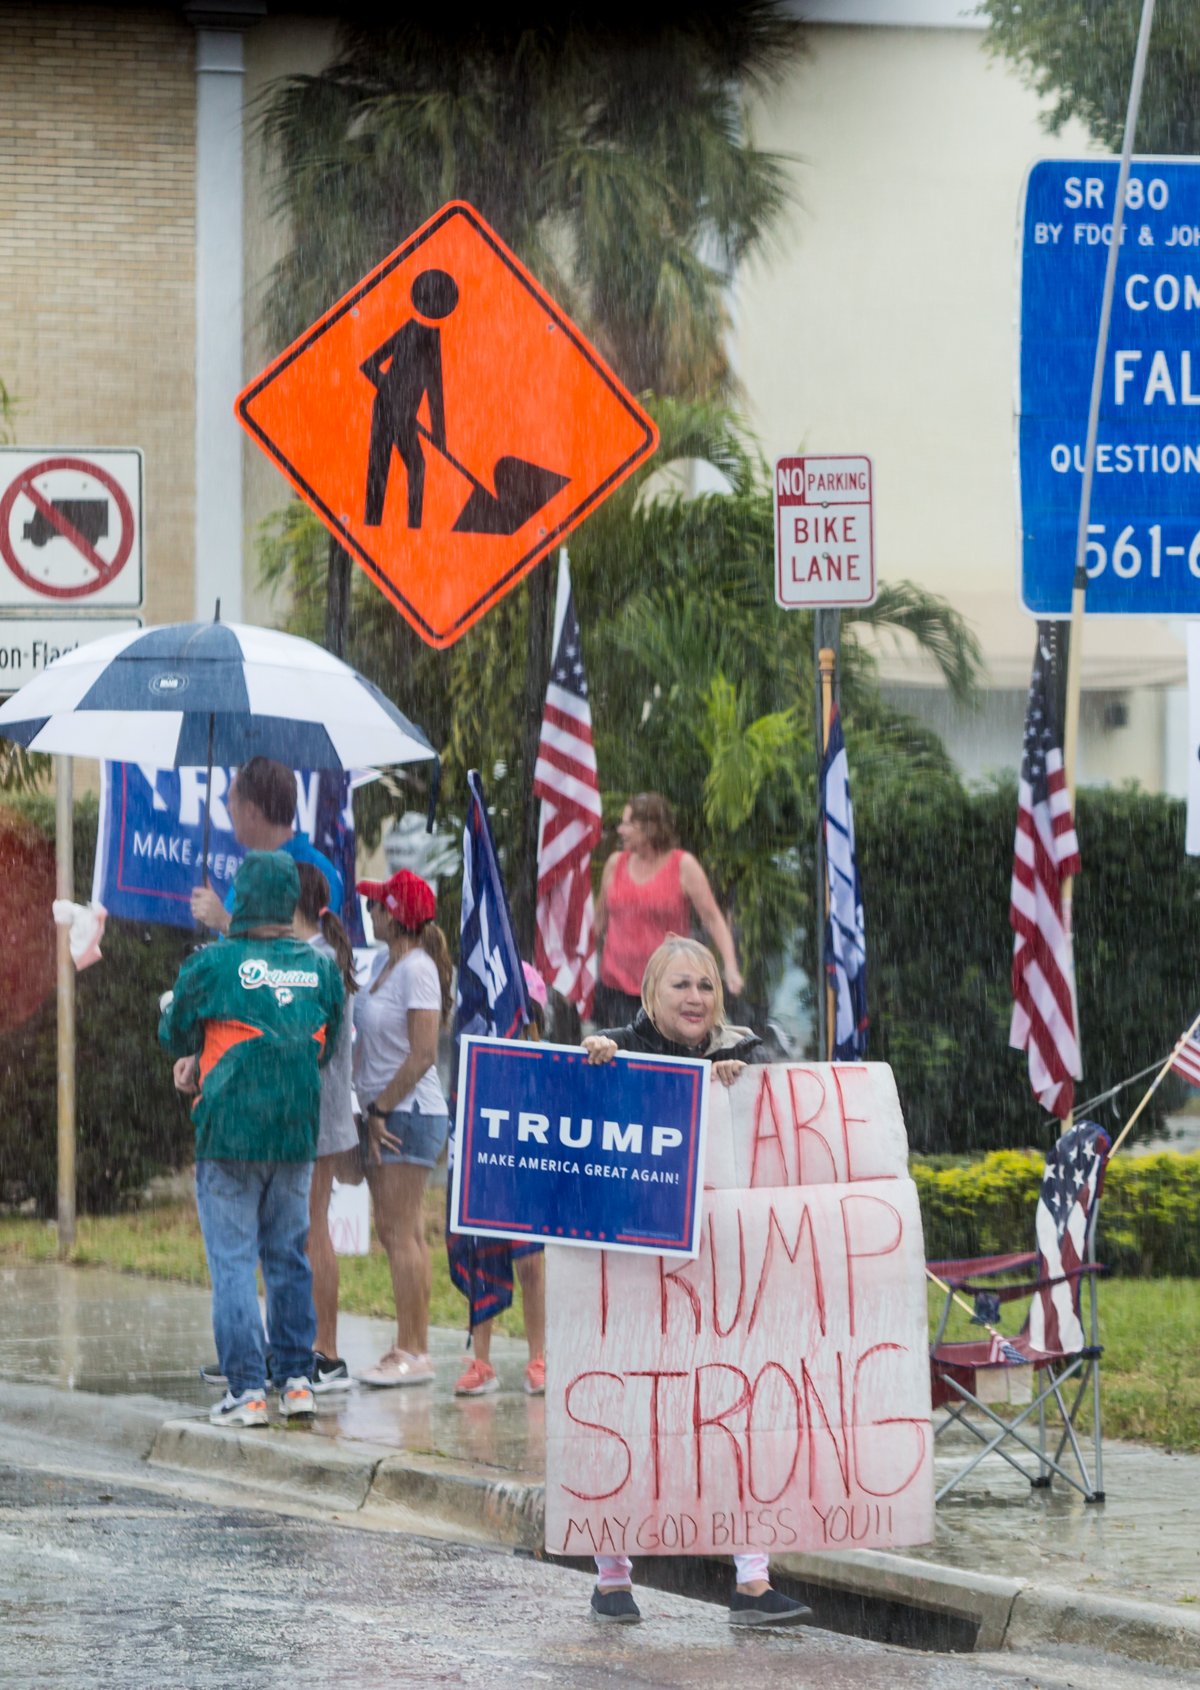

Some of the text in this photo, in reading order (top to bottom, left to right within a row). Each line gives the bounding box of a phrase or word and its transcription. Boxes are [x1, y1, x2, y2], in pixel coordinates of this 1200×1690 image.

[1064, 177, 1104, 208] SR
[1125, 178, 1169, 210] 80
[1035, 223, 1063, 244] BY
[1138, 225, 1154, 245] &
[778, 468, 866, 496] NO PARKING
[794, 517, 856, 544] BIKE
[792, 555, 860, 582] LANE
[133, 831, 192, 866] MAKE
[480, 1107, 683, 1157] TRUMP
[751, 1066, 897, 1190] ARE
[477, 1151, 679, 1185] MAKE AMERICA GREAT AGAIN!
[561, 1343, 932, 1504] STRONG
[563, 1504, 893, 1552] MAY GOD BLESS YOU!!
